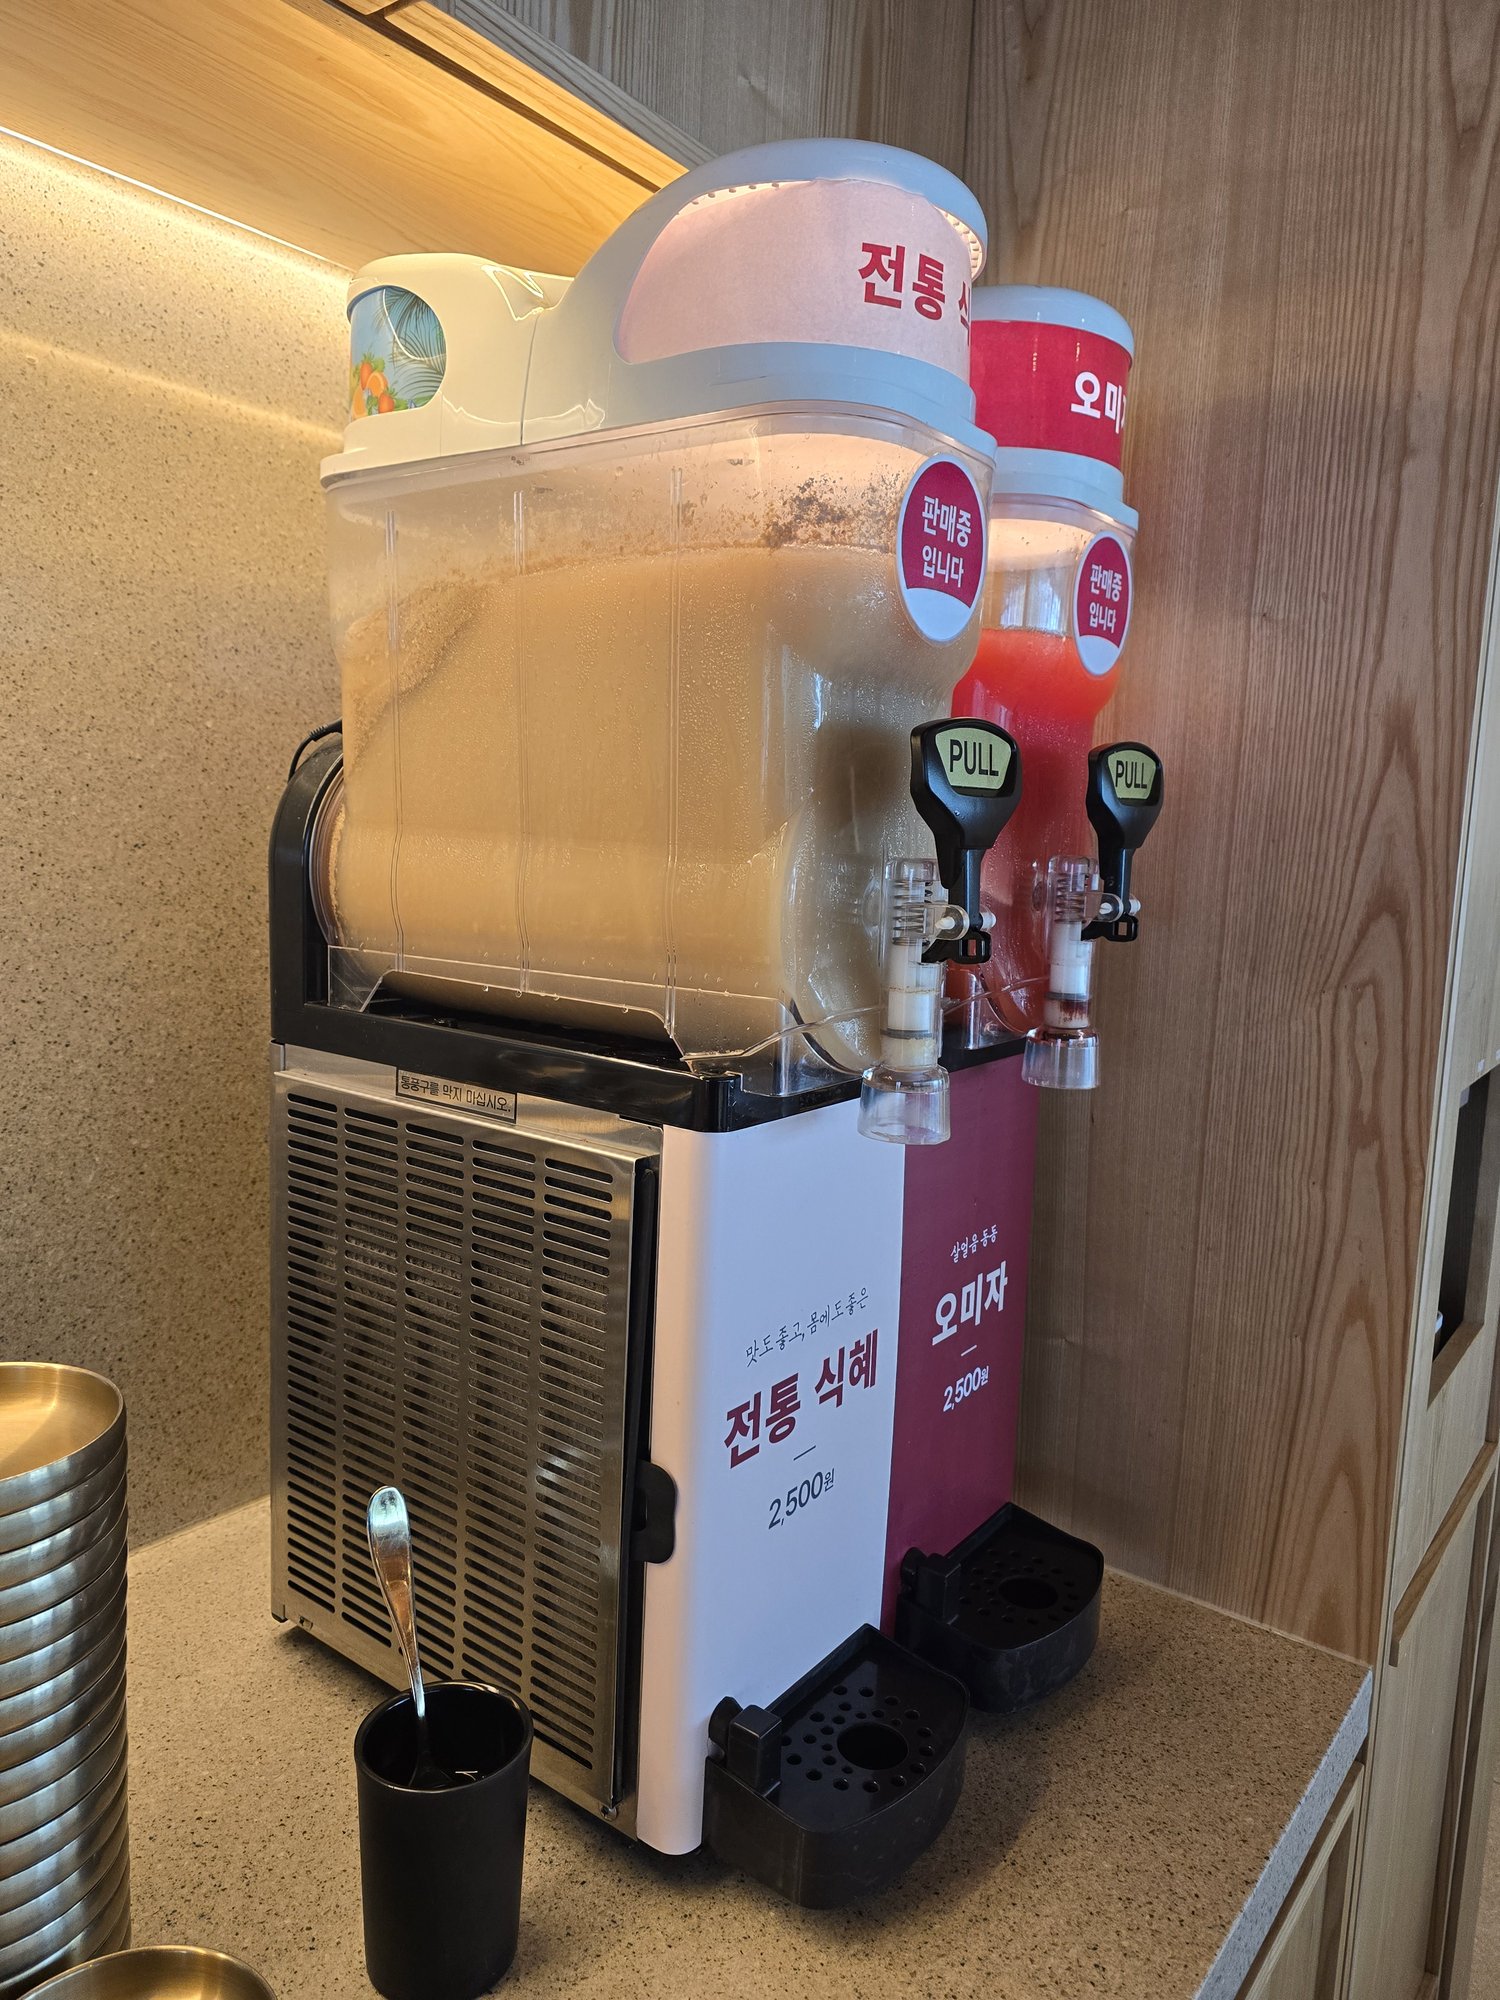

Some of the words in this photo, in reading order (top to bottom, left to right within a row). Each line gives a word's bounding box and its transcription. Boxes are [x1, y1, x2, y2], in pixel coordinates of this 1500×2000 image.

[858, 242, 946, 320] 전통
[922, 495, 972, 548] 판매중
[922, 544, 965, 588] 입니다
[1089, 563, 1122, 602] 판매중
[1088, 602, 1117, 633] 입니다
[949, 738, 999, 777] PULL
[1115, 760, 1148, 789] PULL
[400, 1075, 440, 1096] 통풍구를
[442, 1084, 462, 1102] 막지
[950, 1232, 979, 1264] 살얼음
[980, 1223, 999, 1248] 동동
[931, 1260, 1008, 1346] 오미자
[724, 1372, 802, 1469] 전통
[814, 1328, 878, 1409] 식혜
[942, 1365, 989, 1413] 2,500원
[768, 1467, 835, 1530] 2,500원
